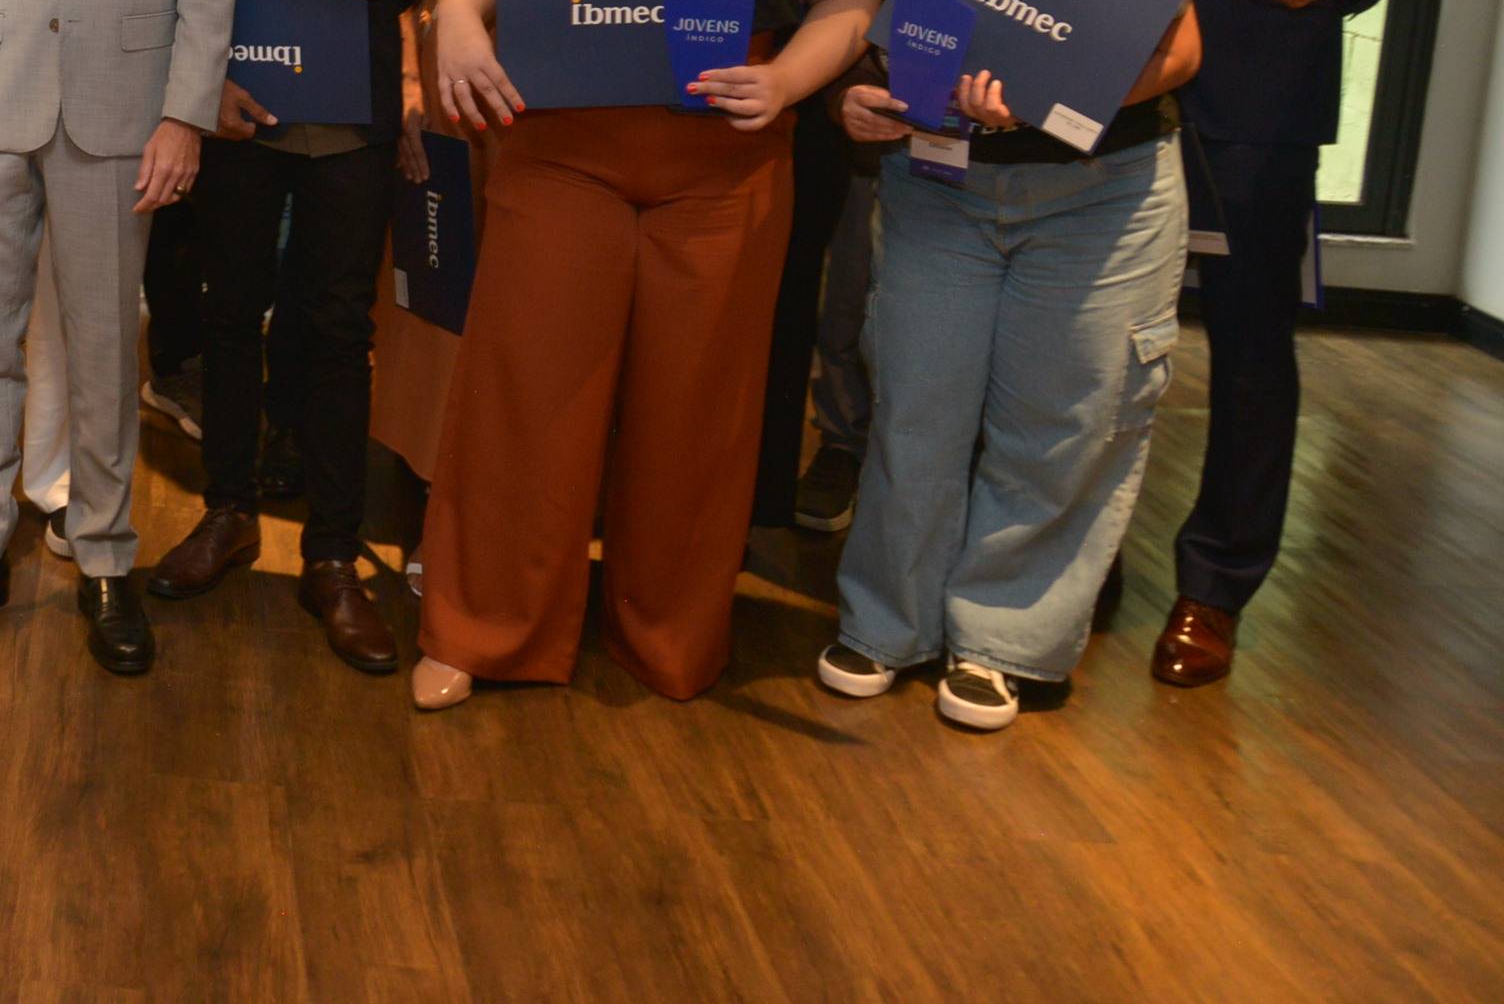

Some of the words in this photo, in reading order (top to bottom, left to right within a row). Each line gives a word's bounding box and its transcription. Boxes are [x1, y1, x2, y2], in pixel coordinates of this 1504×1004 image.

[673, 18, 740, 33] JOVENS
[898, 21, 958, 50] JOVENS
[427, 190, 443, 269] ibmec
